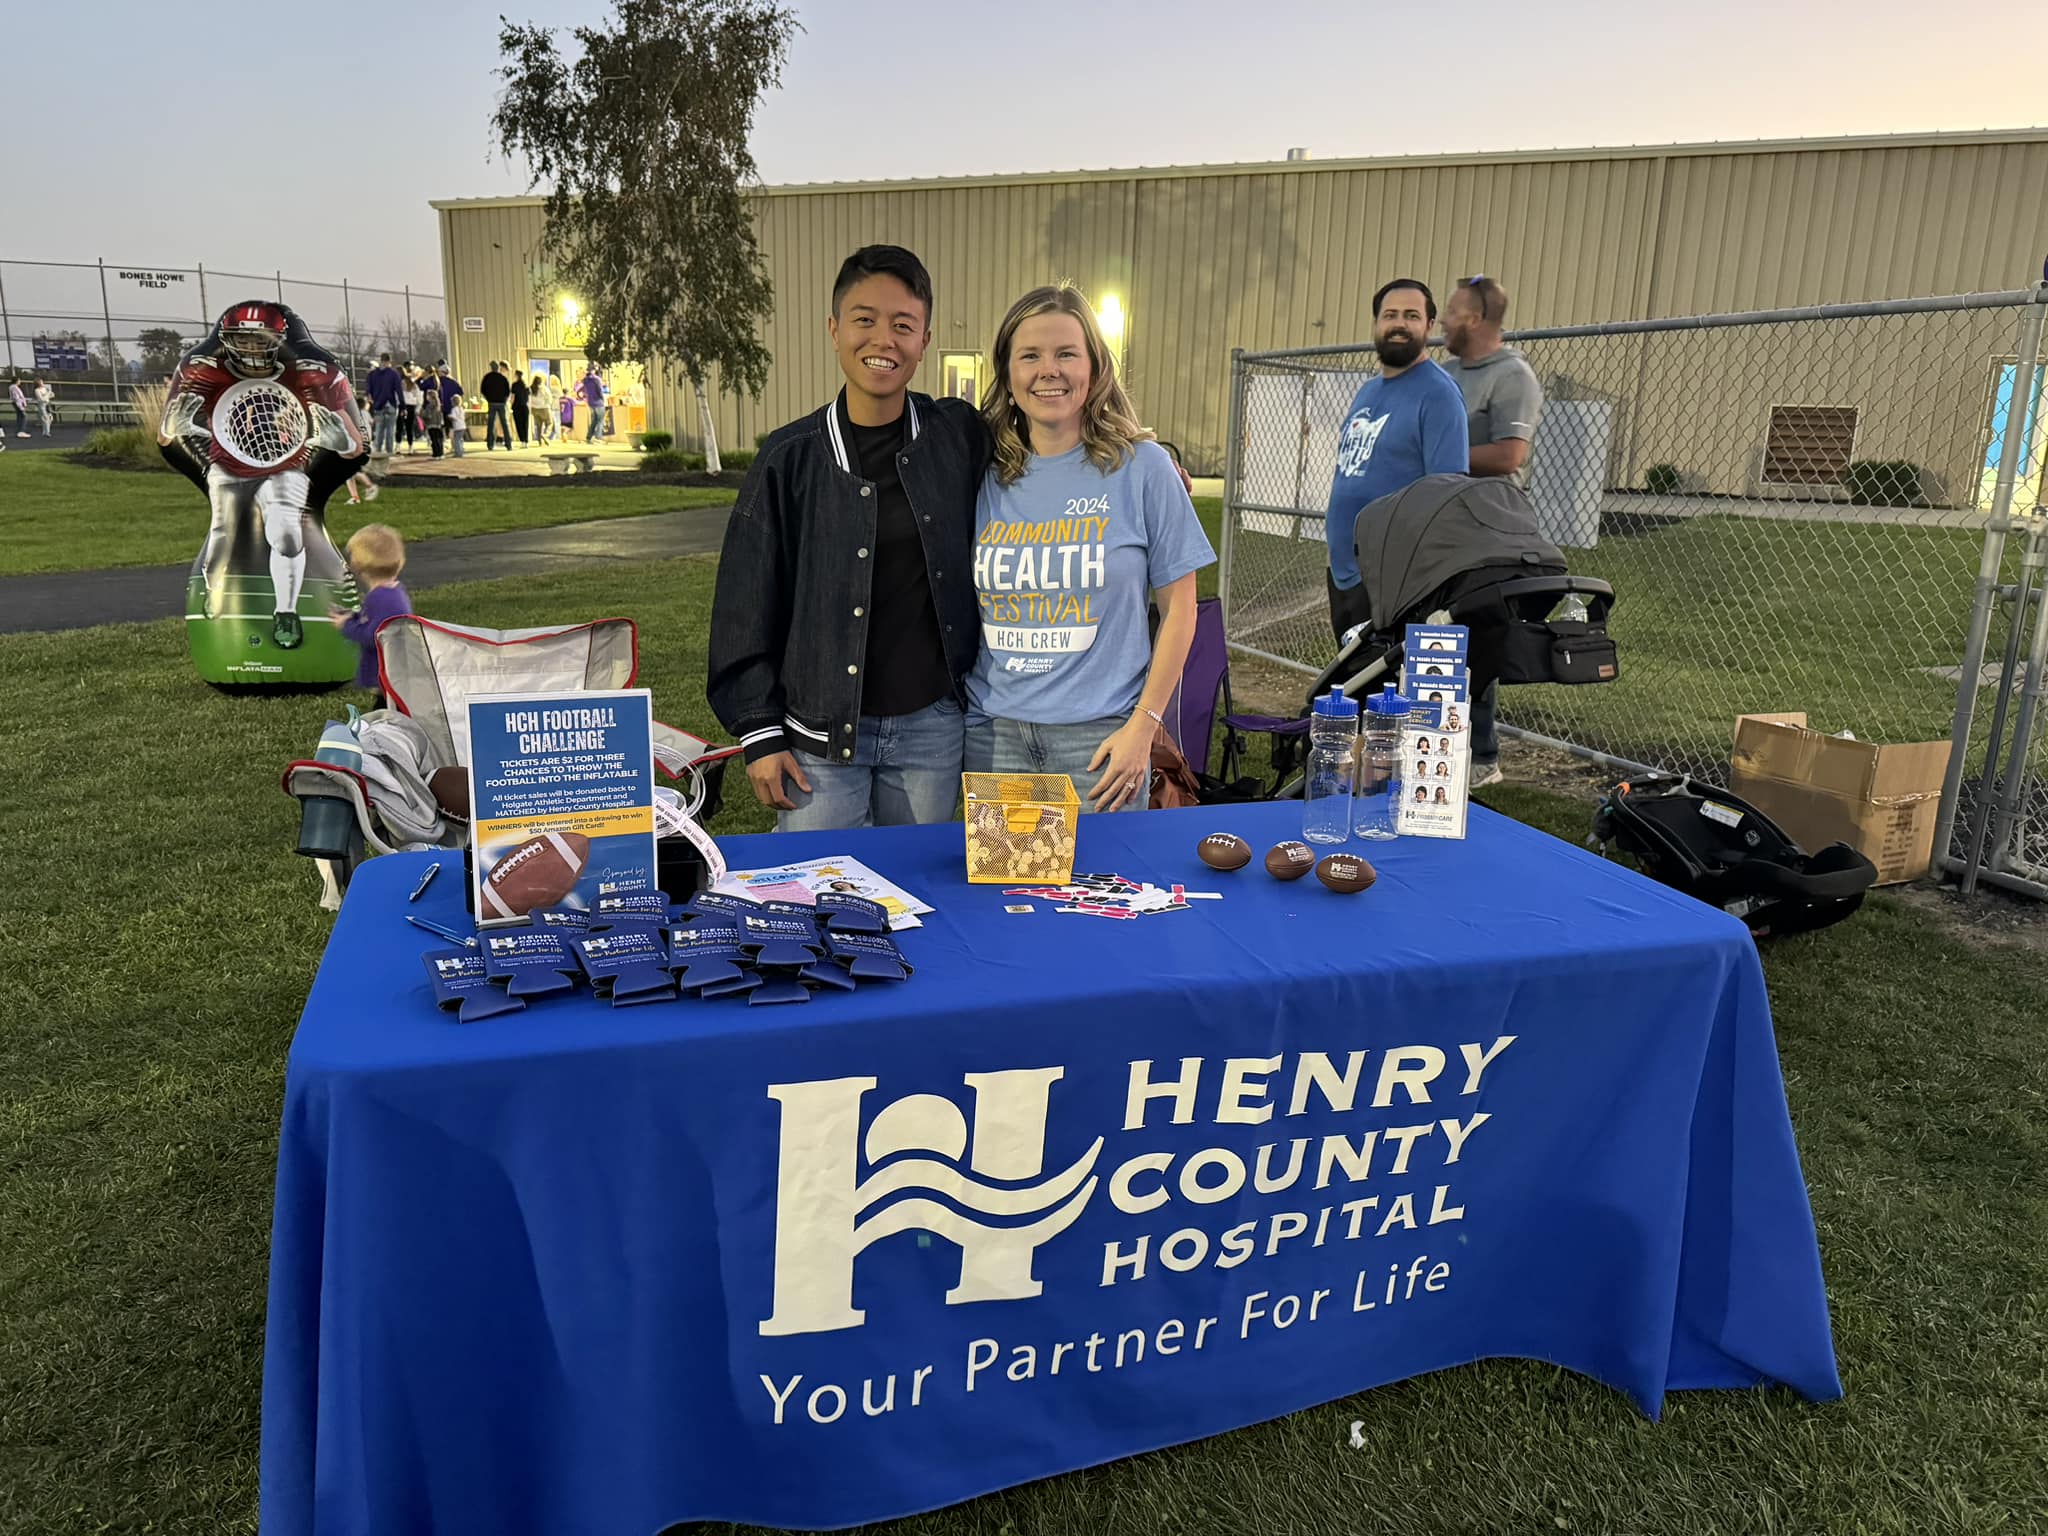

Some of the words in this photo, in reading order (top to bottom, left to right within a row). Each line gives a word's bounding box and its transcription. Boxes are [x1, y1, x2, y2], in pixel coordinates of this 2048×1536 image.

[120, 272, 153, 280] BONES
[156, 273, 184, 281] HOWE
[139, 280, 167, 288] FIELD
[1064, 494, 1110, 515] 2024
[979, 516, 1110, 545] COMMUNITY
[974, 544, 1105, 591] HEALTH
[997, 630, 1024, 648] HCH
[1031, 630, 1071, 649] CREW
[505, 712, 539, 732] HCH
[543, 708, 616, 731] FOOTBALL
[520, 730, 606, 754] CHALLENGE
[500, 759, 540, 768] TICKETS
[541, 757, 560, 766] ARE
[562, 756, 573, 764] $2
[575, 755, 594, 763] FOR
[595, 753, 625, 762] THREE
[504, 766, 550, 776] CHANCES
[551, 765, 565, 774] TO
[566, 764, 602, 772] THROW
[604, 762, 622, 770] THE
[486, 778, 536, 787] FOOTBALL
[538, 776, 560, 784] INTO
[562, 773, 581, 782] THE
[583, 770, 638, 780] INFLATABLE
[502, 800, 534, 810] Holgate
[534, 797, 565, 806] Athletic
[566, 795, 612, 804] Department
[613, 792, 628, 800] and
[504, 793, 527, 801] ticket
[528, 791, 547, 799] sales
[575, 787, 607, 795] donated
[495, 808, 536, 817] MATCHED
[537, 807, 547, 815] by
[548, 804, 573, 813] Henry
[573, 802, 601, 812] County
[488, 823, 522, 832] WINNERS
[546, 818, 573, 826] entered
[594, 814, 622, 823] drawing
[543, 825, 571, 833] Amazon
[1120, 1033, 1518, 1132] HENRY
[1108, 1112, 1492, 1216] COUNTY
[1098, 1184, 1468, 1288] HOSPITAL
[758, 1364, 936, 1427] Your
[966, 1315, 1219, 1392] Partner
[1240, 1288, 1330, 1341] For
[1352, 1254, 1451, 1314] Life
